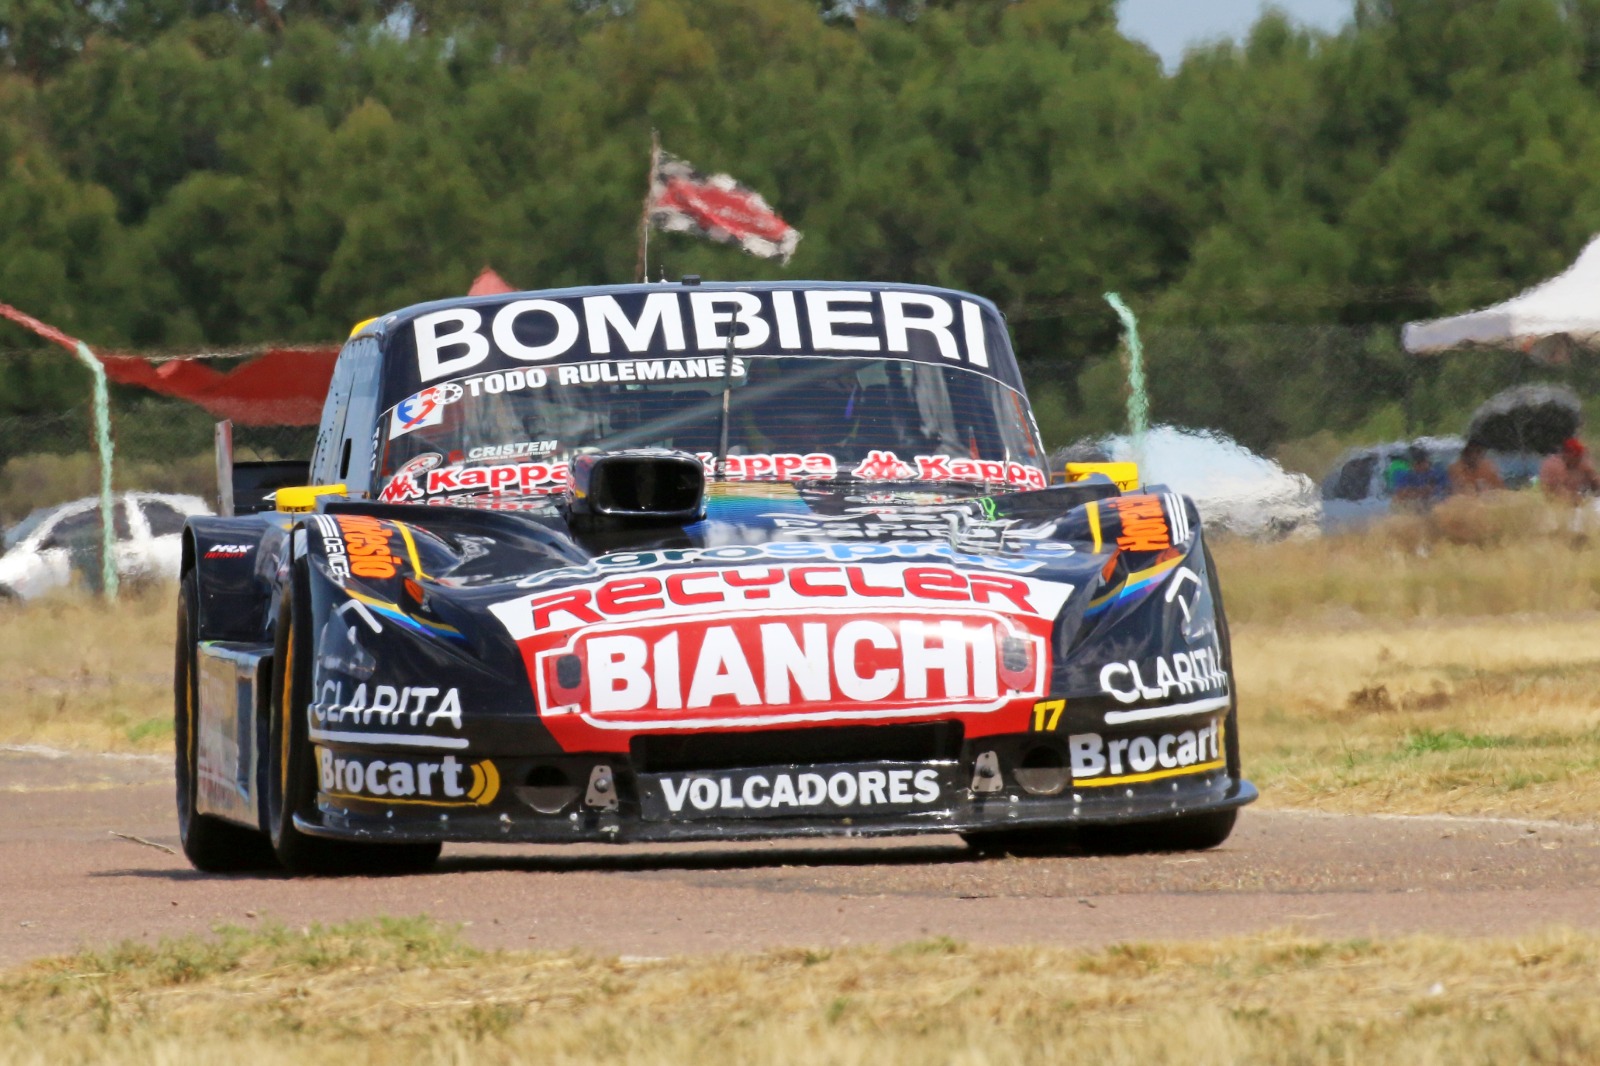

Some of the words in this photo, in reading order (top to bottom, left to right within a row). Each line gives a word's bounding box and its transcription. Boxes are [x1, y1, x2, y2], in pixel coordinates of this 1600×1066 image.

[414, 290, 989, 383] BOMBIERI
[465, 369, 547, 397] TODO
[559, 357, 746, 386] RULEMANES
[468, 440, 558, 459] CRISTEM
[914, 455, 1047, 489] Kappa
[427, 462, 569, 489] Kappa
[586, 620, 1000, 713] BIANCHI
[1100, 646, 1228, 704] CLARITA
[315, 680, 462, 730] CLARITA
[1033, 699, 1066, 732] 17
[1069, 718, 1218, 778] Brocart
[320, 747, 465, 797] Brocart
[659, 769, 940, 812] VOLCADORES
